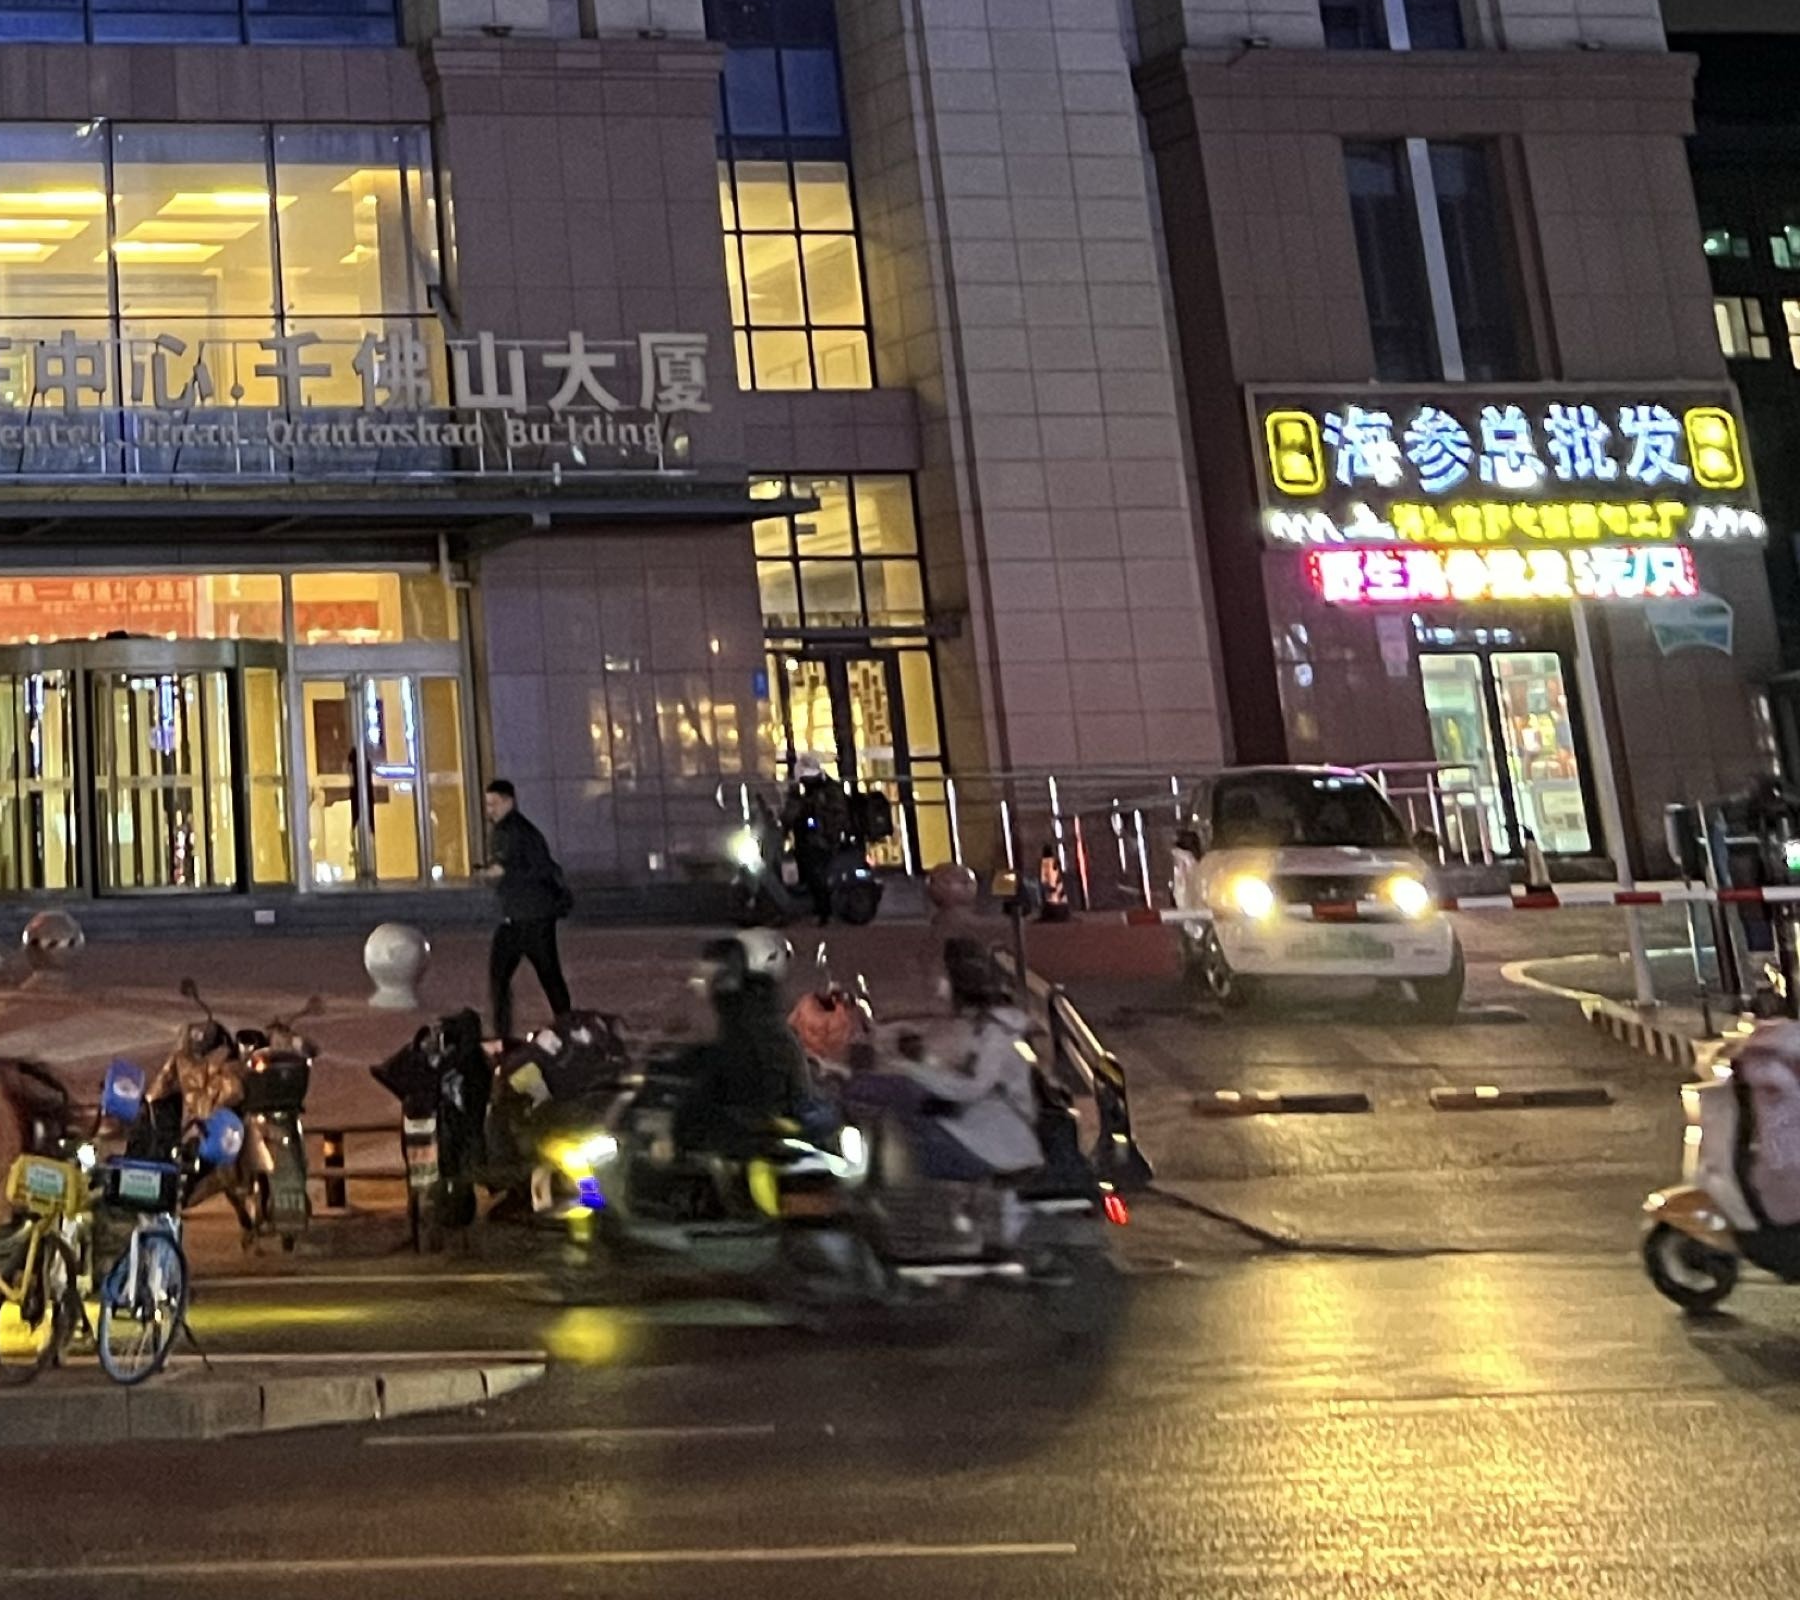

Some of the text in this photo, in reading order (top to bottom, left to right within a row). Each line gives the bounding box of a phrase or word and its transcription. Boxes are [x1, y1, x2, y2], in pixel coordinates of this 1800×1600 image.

[506, 415, 662, 454] Bulding
[1322, 405, 1691, 492] 海参总批发
